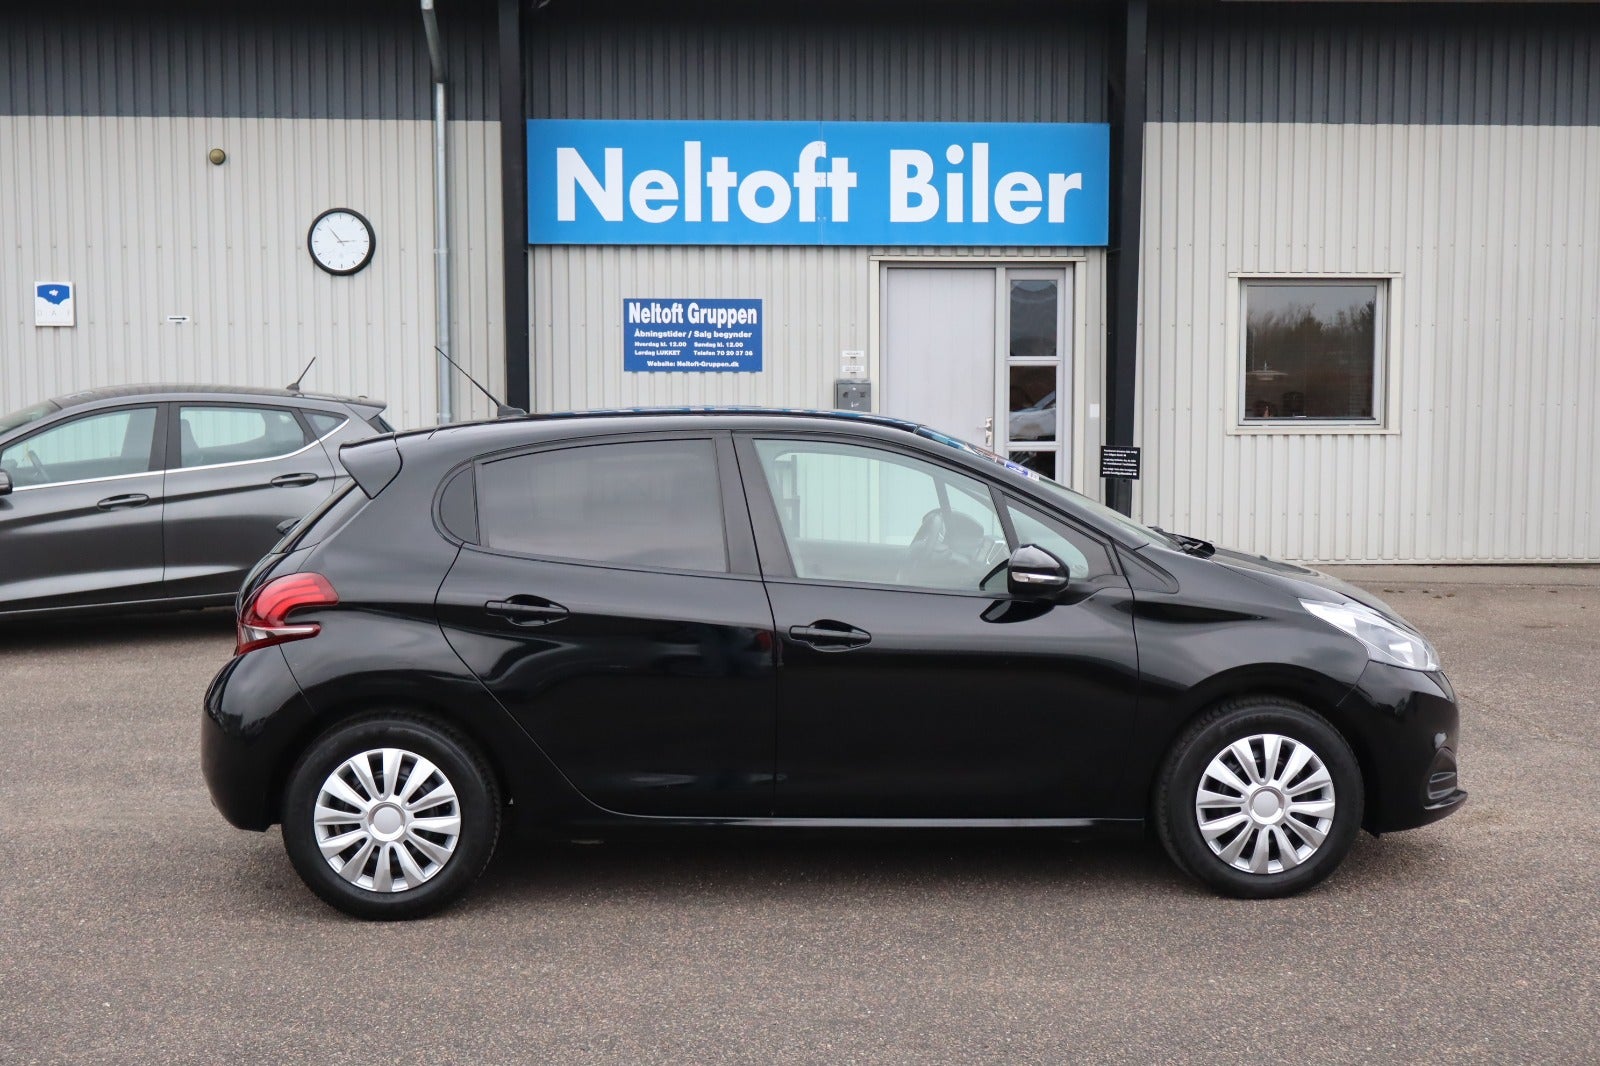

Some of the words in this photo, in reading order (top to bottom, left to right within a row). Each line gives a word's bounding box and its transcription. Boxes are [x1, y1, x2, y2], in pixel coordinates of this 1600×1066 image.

[557, 141, 857, 223] Neltoft
[890, 143, 1081, 224] Biler
[629, 302, 683, 324] Neltoft
[688, 303, 757, 328] Gruppen
[634, 328, 686, 338] Åbningstider
[714, 331, 752, 339] begynder
